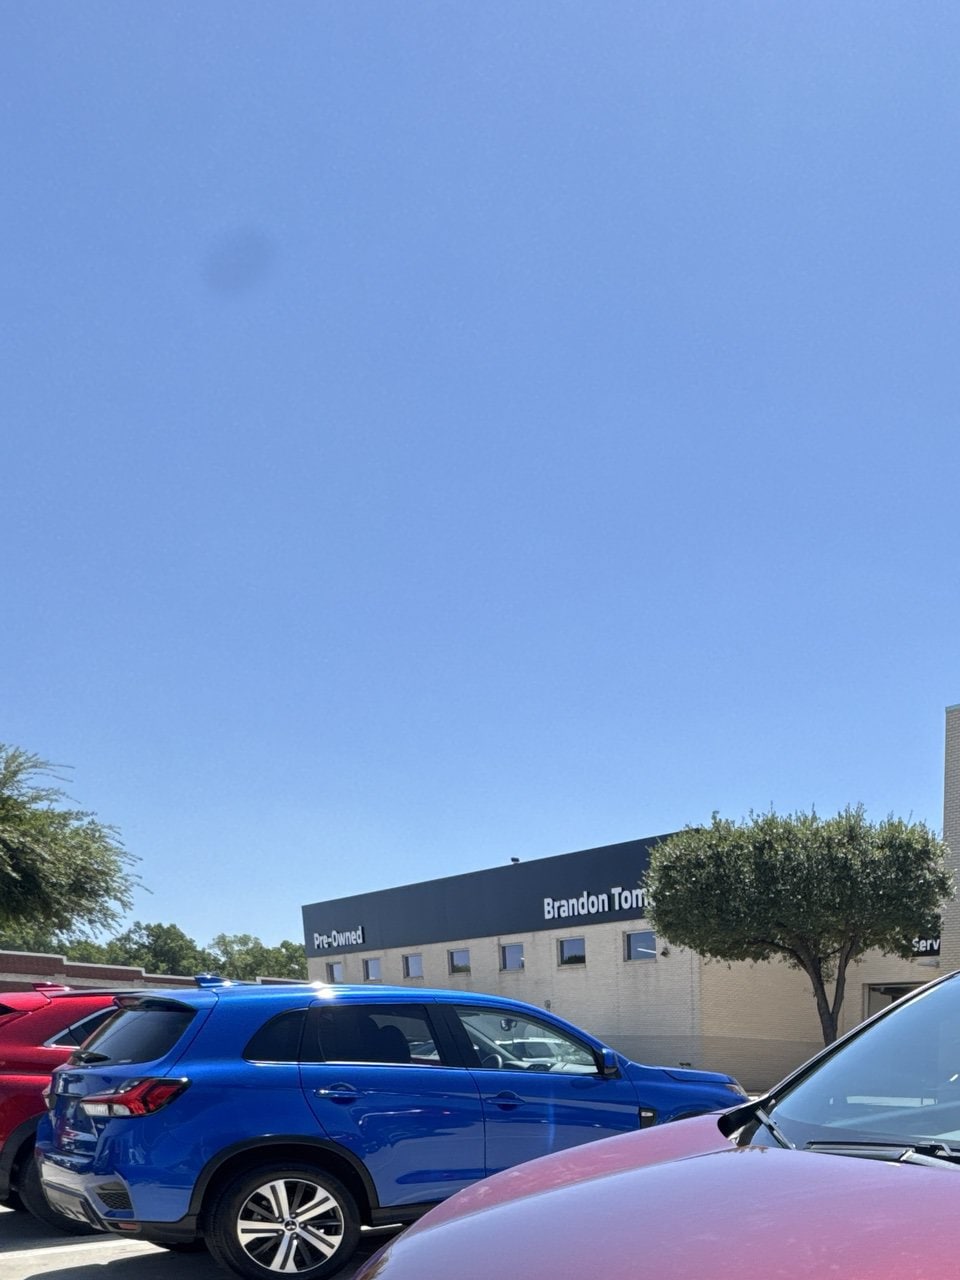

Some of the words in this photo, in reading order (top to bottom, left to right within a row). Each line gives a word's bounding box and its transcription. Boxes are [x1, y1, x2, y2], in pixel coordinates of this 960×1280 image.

[543, 890, 609, 920] Brandon
[611, 886, 650, 911] Tom
[313, 925, 363, 949] Pre-Owned
[911, 936, 941, 952] Serv
